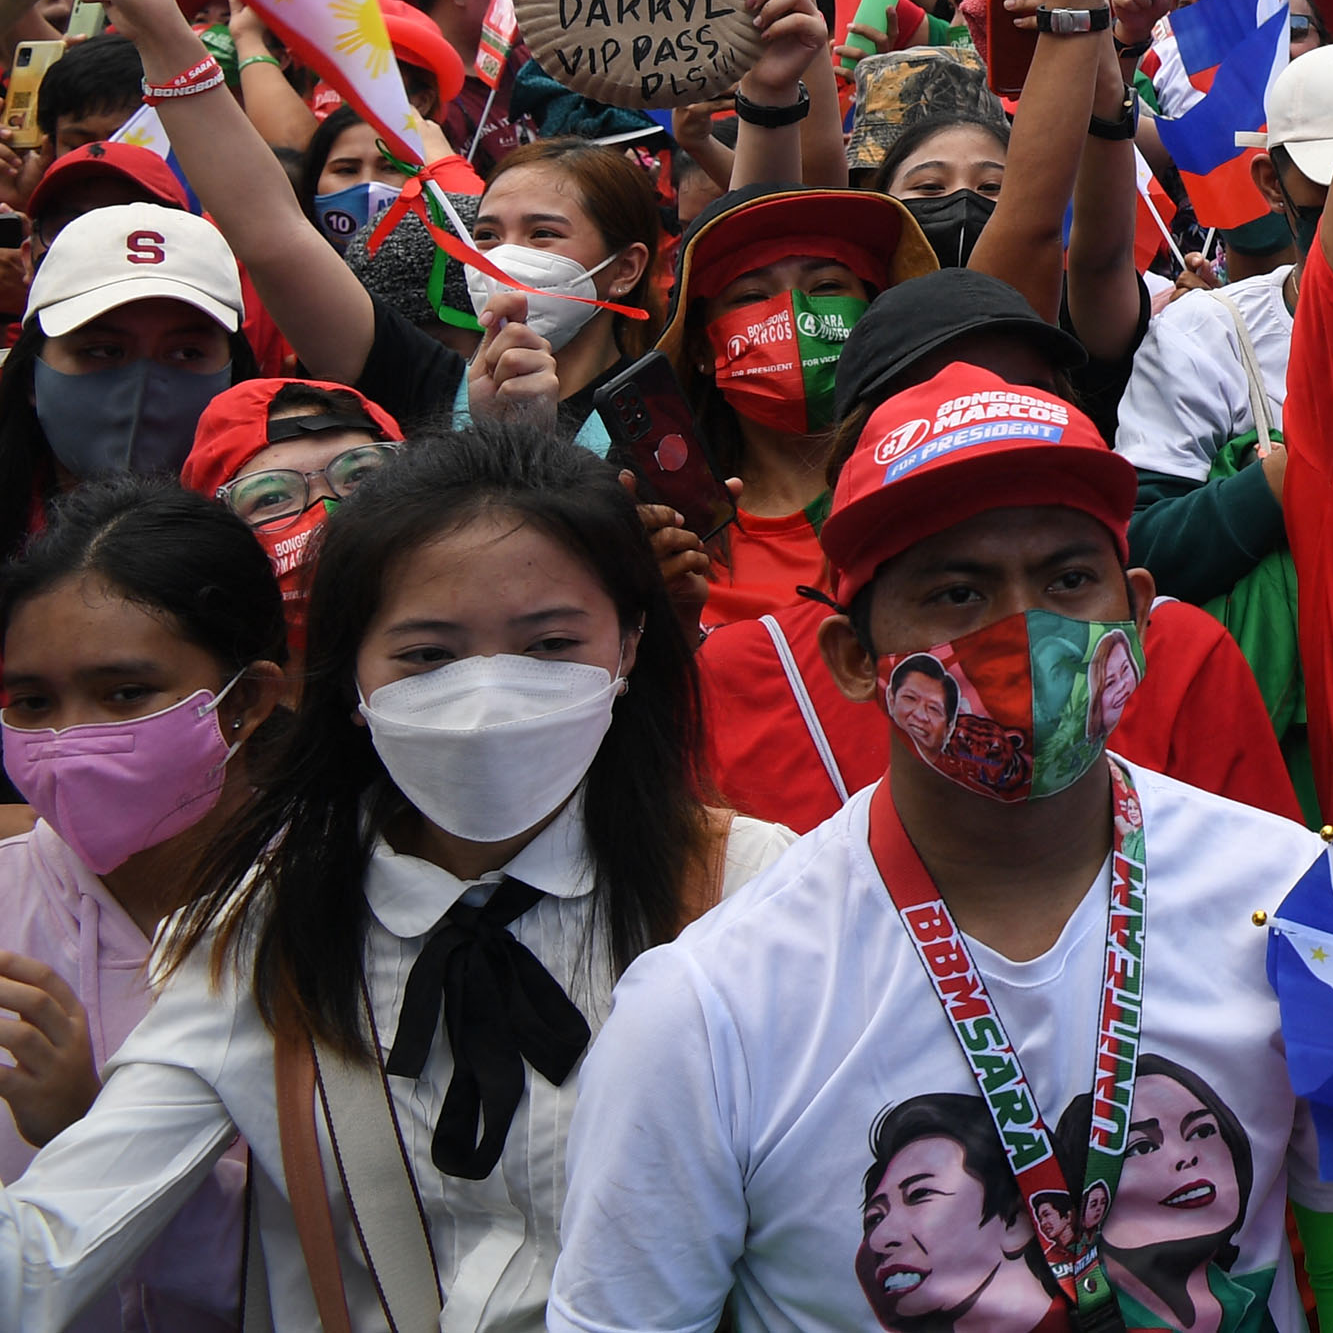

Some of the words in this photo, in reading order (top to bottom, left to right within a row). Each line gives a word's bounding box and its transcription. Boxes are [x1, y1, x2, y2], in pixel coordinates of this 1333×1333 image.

[553, 38, 621, 76] VIP
[632, 24, 719, 71] PASS
[328, 214, 350, 232] 10
[126, 230, 165, 264] S
[750, 322, 793, 346] ARCOS
[804, 315, 817, 334] 4
[731, 339, 740, 357] 7
[802, 358, 820, 367] FOR
[935, 391, 1067, 417] BONGBONG
[932, 403, 1069, 434] MARCOS
[881, 419, 923, 459] #7
[891, 455, 917, 477] FOR
[274, 529, 312, 557] BONGB
[1090, 851, 1148, 1156] UNITEAM
